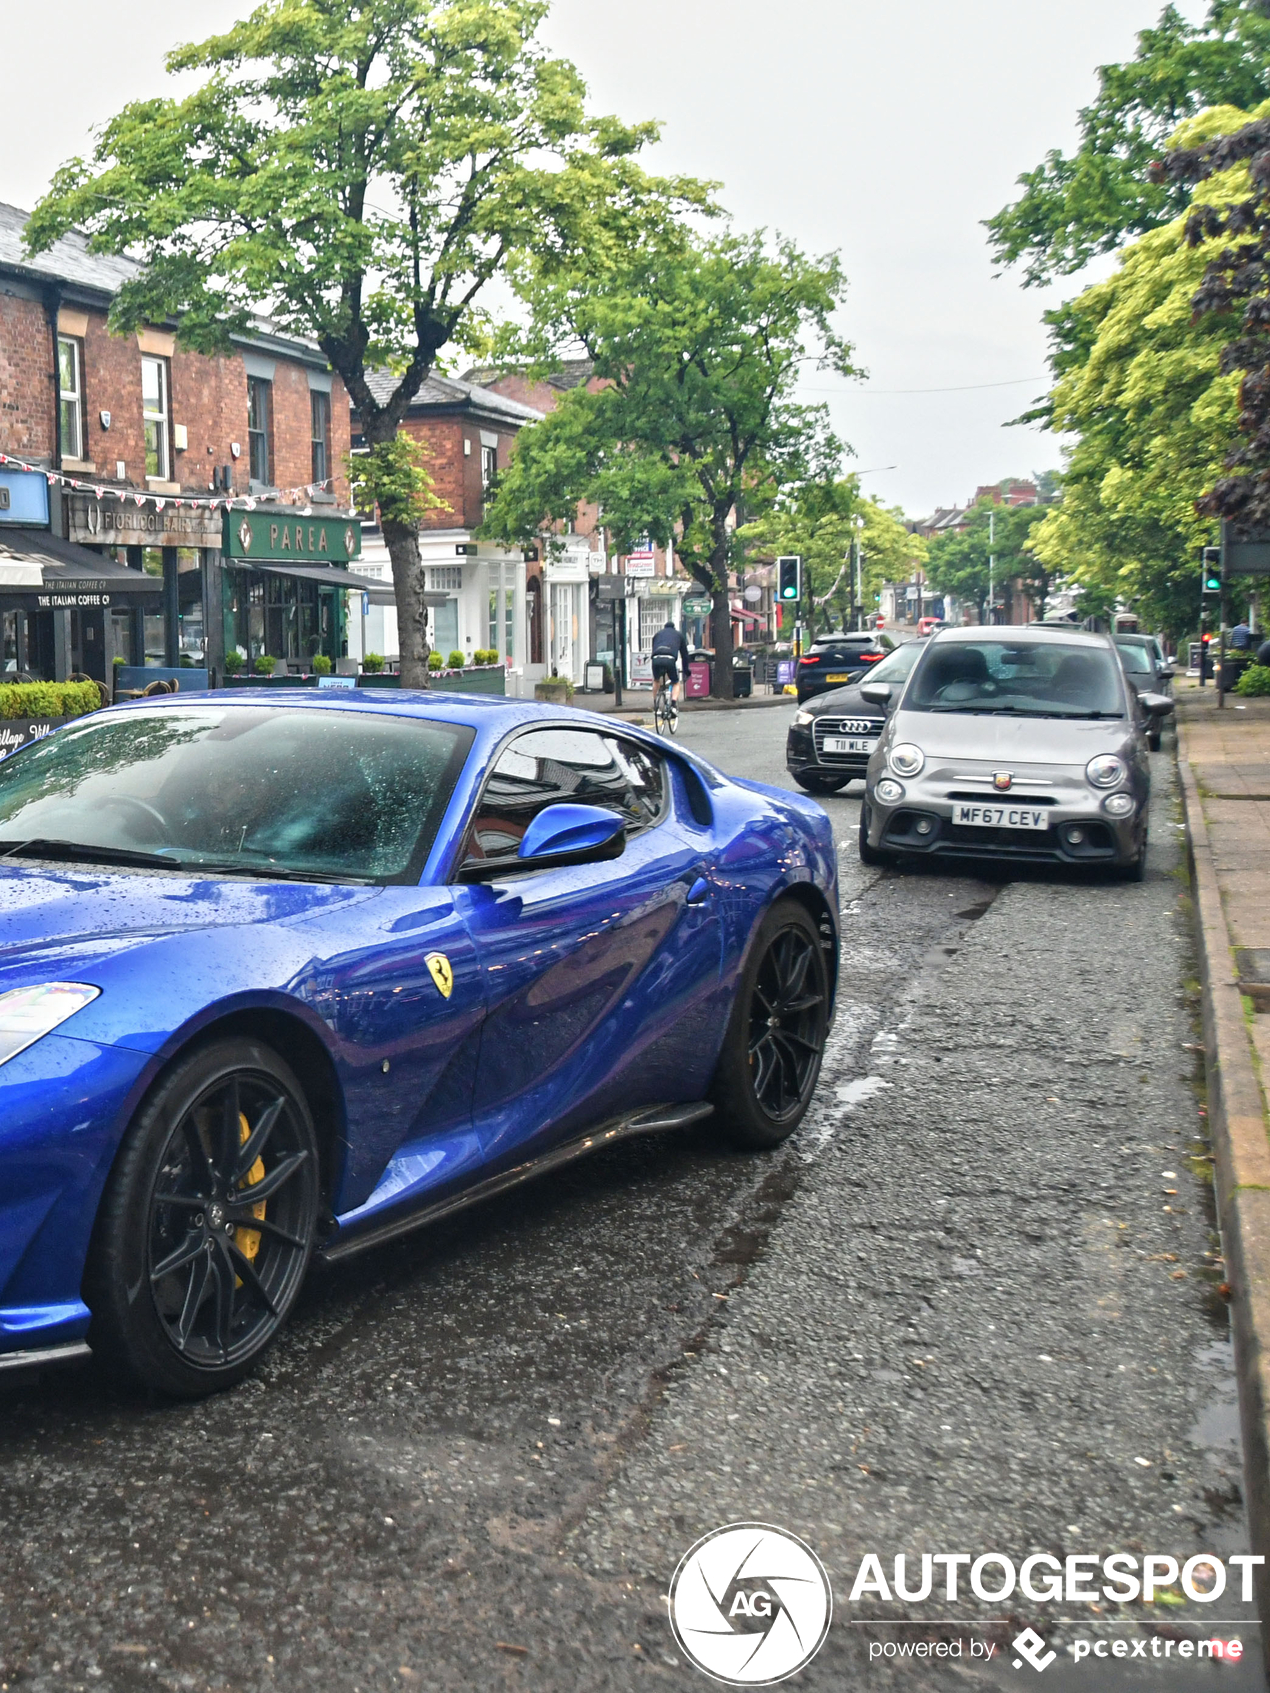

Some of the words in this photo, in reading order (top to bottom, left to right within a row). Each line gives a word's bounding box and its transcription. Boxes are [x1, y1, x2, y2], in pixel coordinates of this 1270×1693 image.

[270, 524, 328, 552] PAREA
[44, 581, 55, 590] THE
[56, 581, 77, 590] ITALIAN
[79, 581, 98, 590] COFFEE
[38, 596, 50, 607] THE
[51, 595, 77, 606] ITALIAN
[78, 595, 101, 606] COFFEE
[848, 741, 869, 752] WLE
[960, 807, 1004, 824] MF67
[1008, 811, 1041, 826] CEV
